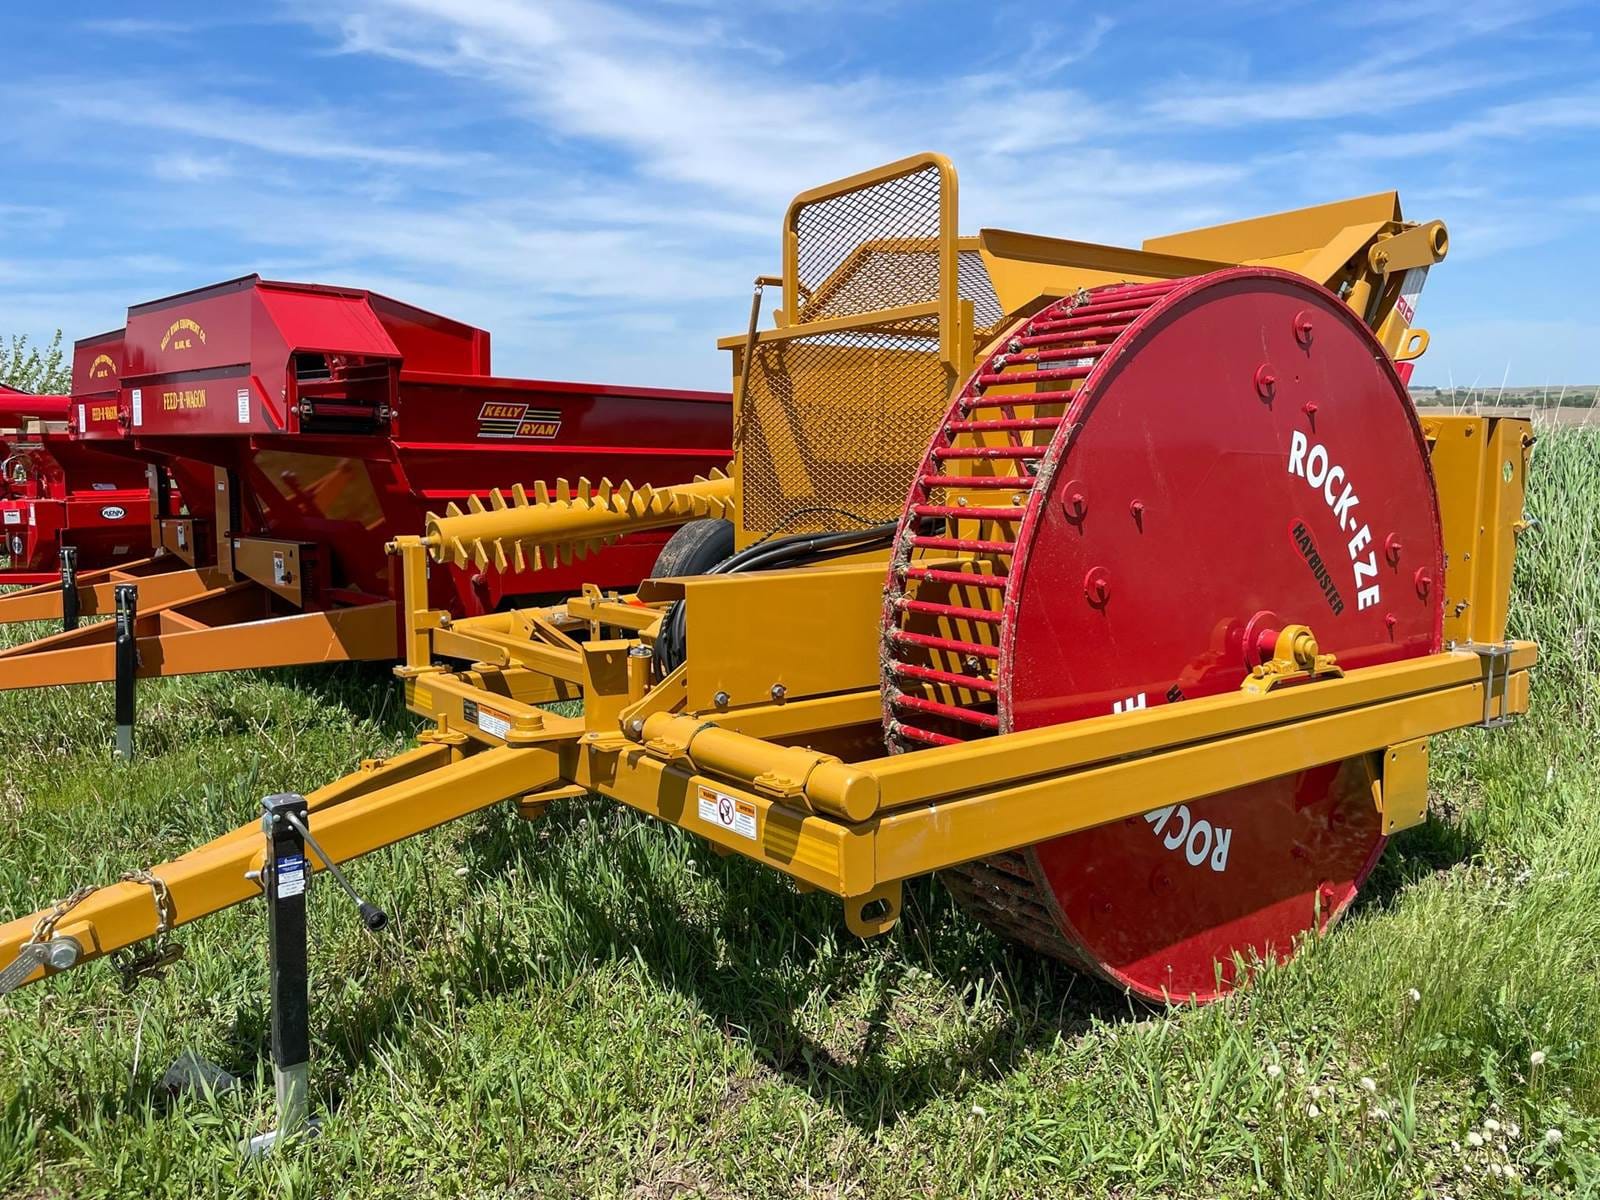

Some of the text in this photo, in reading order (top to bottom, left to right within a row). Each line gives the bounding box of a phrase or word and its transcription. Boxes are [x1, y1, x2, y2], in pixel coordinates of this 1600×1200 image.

[163, 389, 206, 411] FEED-R-WAGON
[484, 405, 523, 417] KELLY
[520, 423, 556, 435] RYAN
[1287, 429, 1381, 612] ROCK-EZE
[1292, 523, 1345, 617] HAYBUSTER
